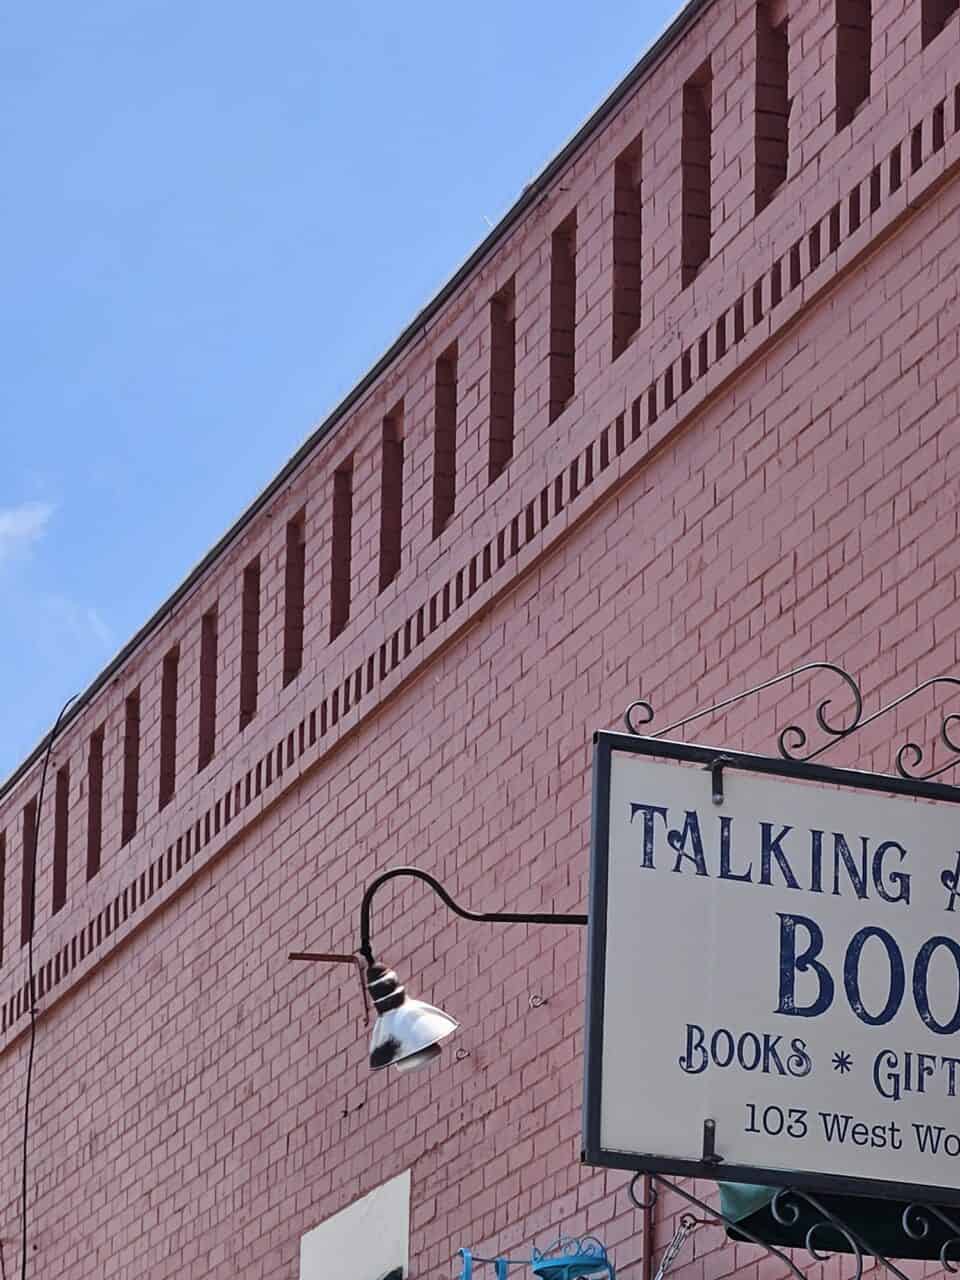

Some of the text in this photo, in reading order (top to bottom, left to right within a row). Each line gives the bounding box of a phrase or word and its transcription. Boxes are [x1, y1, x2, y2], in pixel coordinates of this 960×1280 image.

[630, 803, 912, 905] TALKING
[679, 1023, 812, 1078] BOOKS
[744, 1103, 808, 1139] 103
[818, 1111, 903, 1150] West
